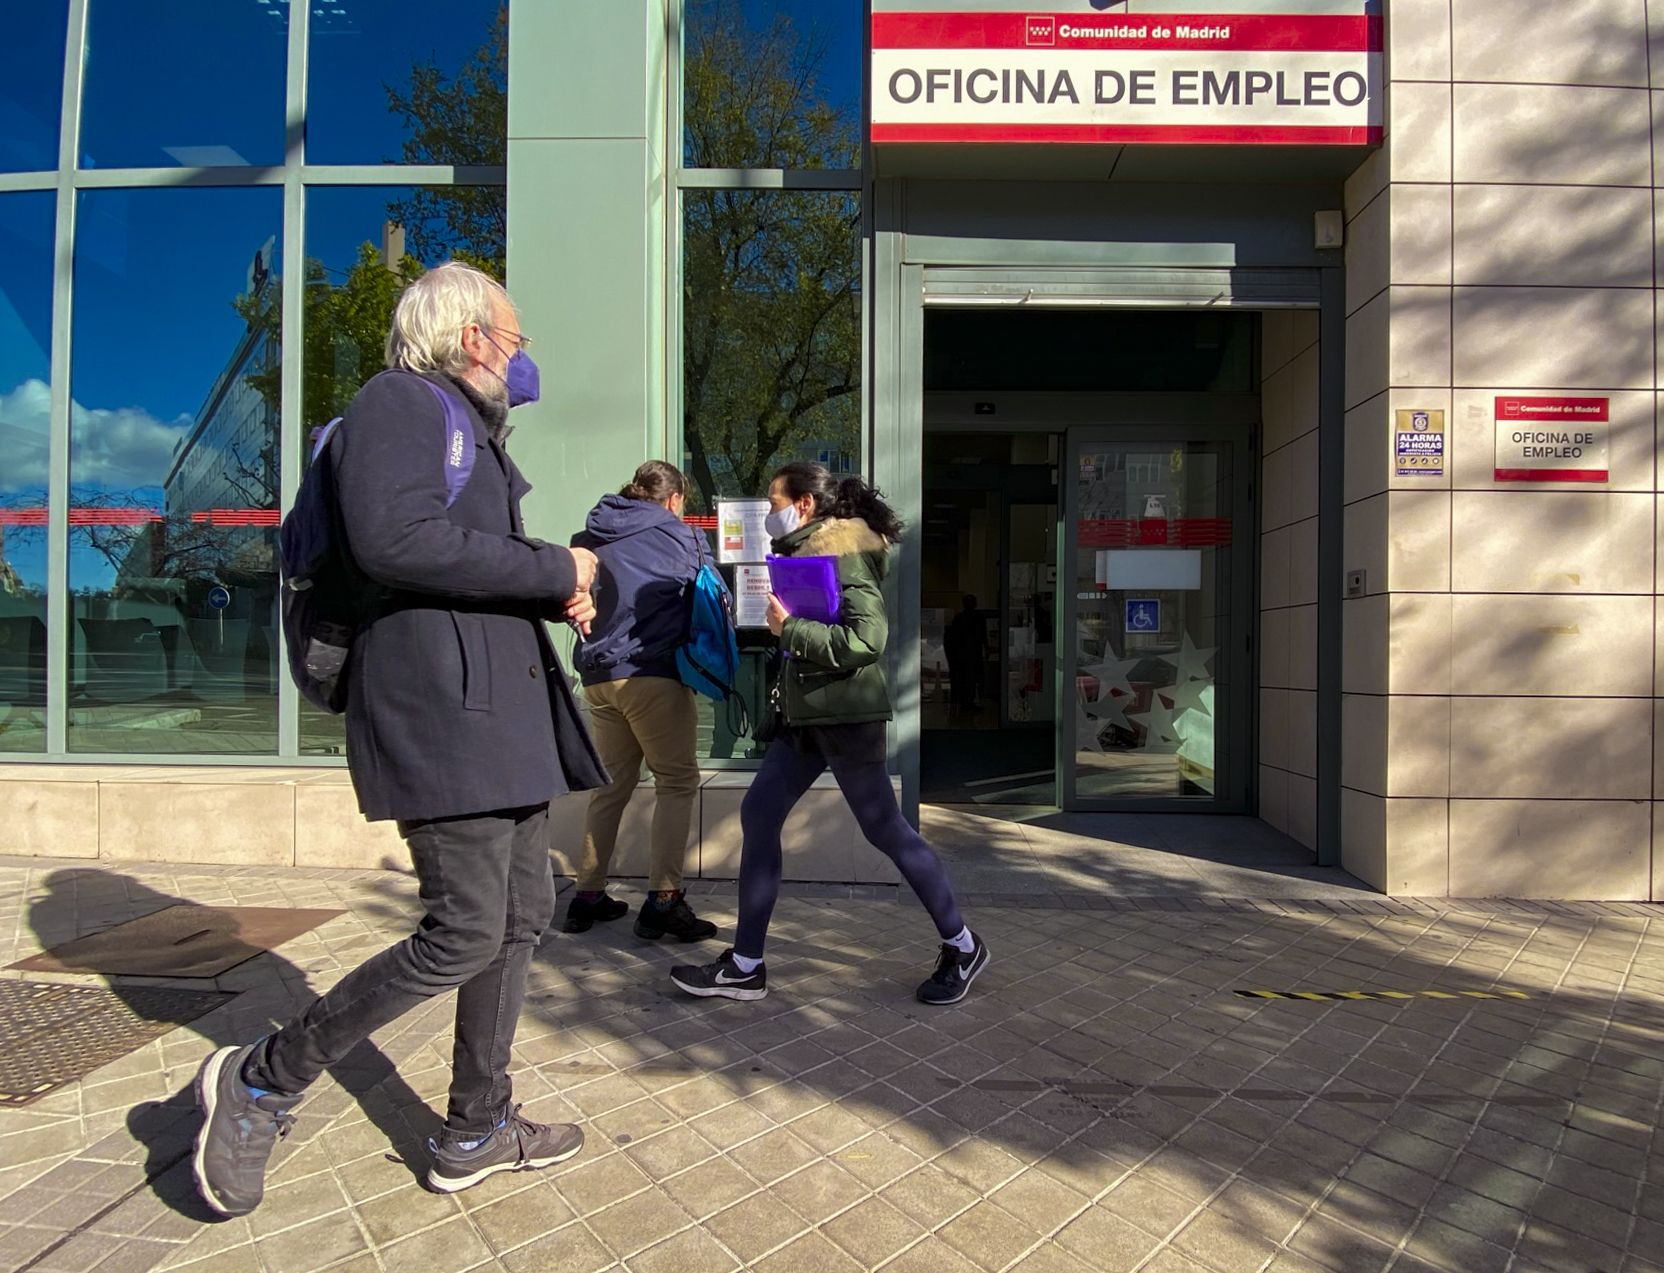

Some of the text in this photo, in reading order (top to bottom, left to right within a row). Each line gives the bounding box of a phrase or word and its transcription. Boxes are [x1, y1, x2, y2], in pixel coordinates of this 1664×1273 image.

[1059, 25, 1230, 40] Comunidad de Madrid
[888, 68, 1368, 106] OFICINA DE EMPLEO
[1520, 405, 1562, 413] Comunidad
[1563, 405, 1573, 413] de
[1399, 434, 1441, 442] ALARMA
[1512, 432, 1593, 444] OFICINA DE
[1523, 447, 1582, 458] EMPLEO
